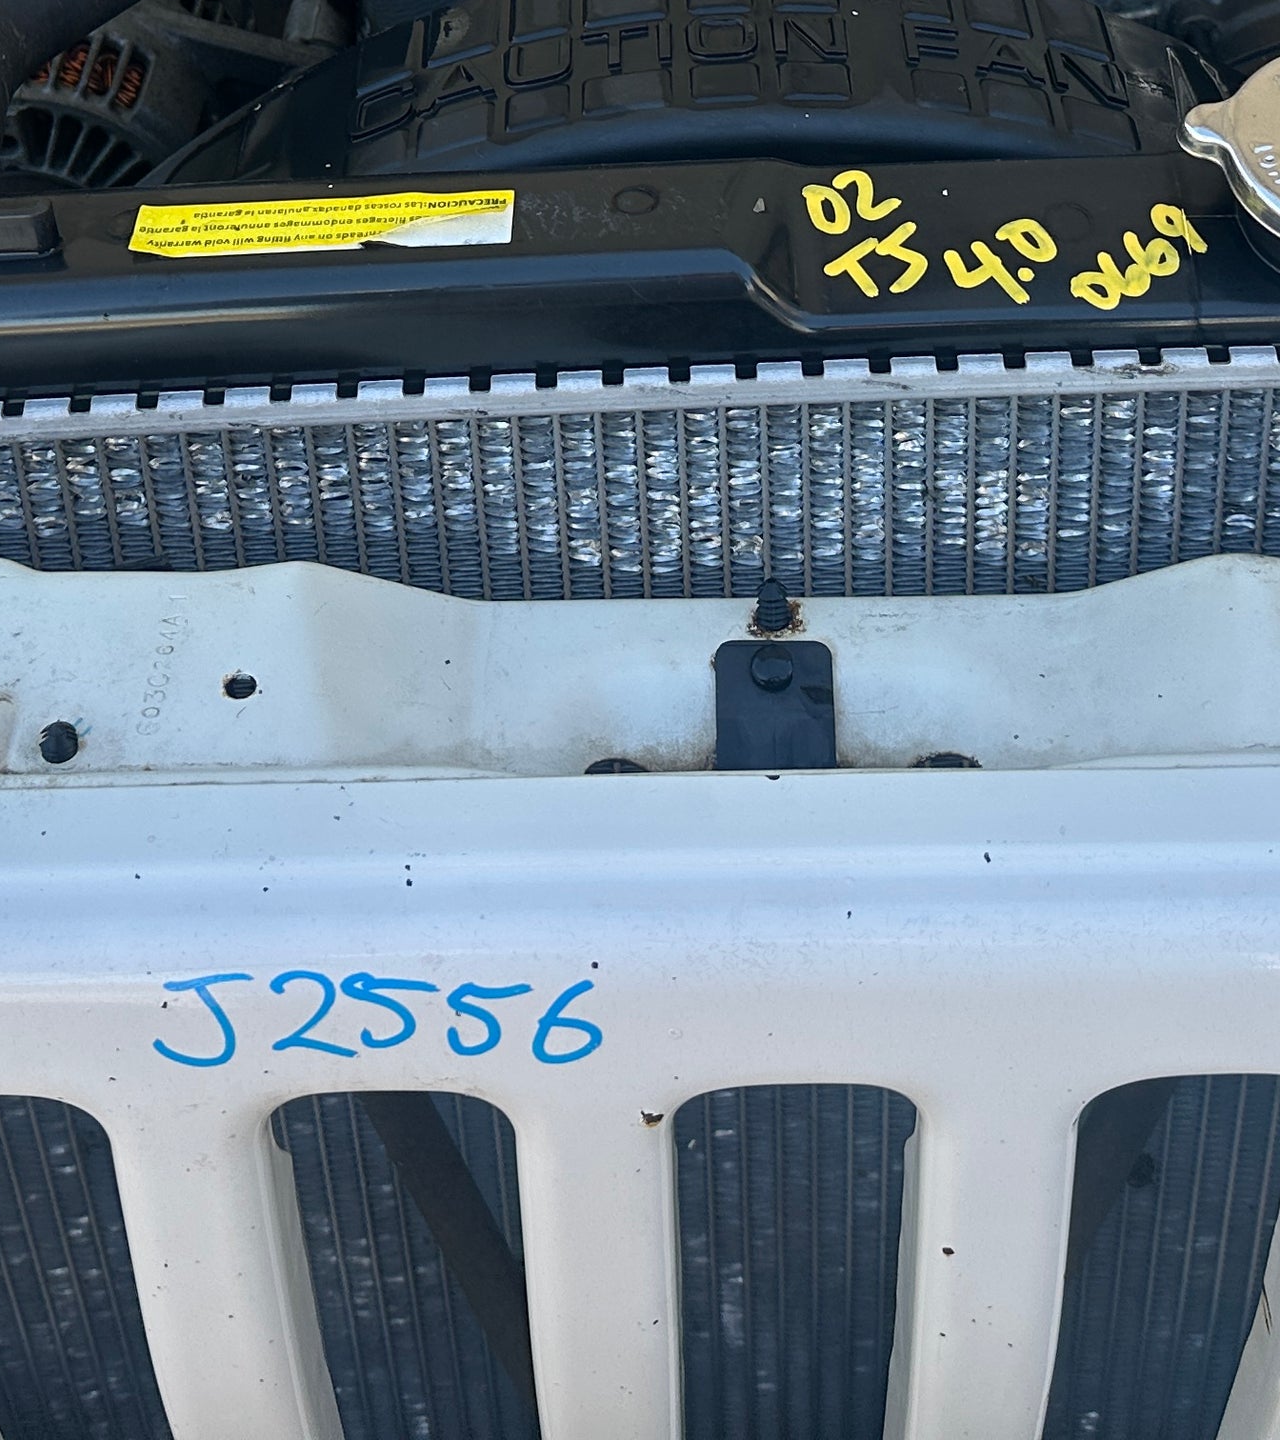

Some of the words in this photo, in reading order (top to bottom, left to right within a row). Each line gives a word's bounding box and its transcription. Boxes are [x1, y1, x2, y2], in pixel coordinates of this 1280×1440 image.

[350, 13, 847, 143] CAUTION
[906, 20, 1129, 108] FAN
[365, 202, 401, 210] roscas
[802, 169, 902, 235] 02
[194, 209, 242, 218] garantia
[274, 218, 353, 228] endommages
[356, 216, 406, 225] filetages
[139, 225, 188, 234] garantie
[147, 240, 201, 248] warranty
[943, 218, 1058, 305] 4.0
[1070, 203, 1209, 311] 0669
[152, 970, 604, 1067] J2556
